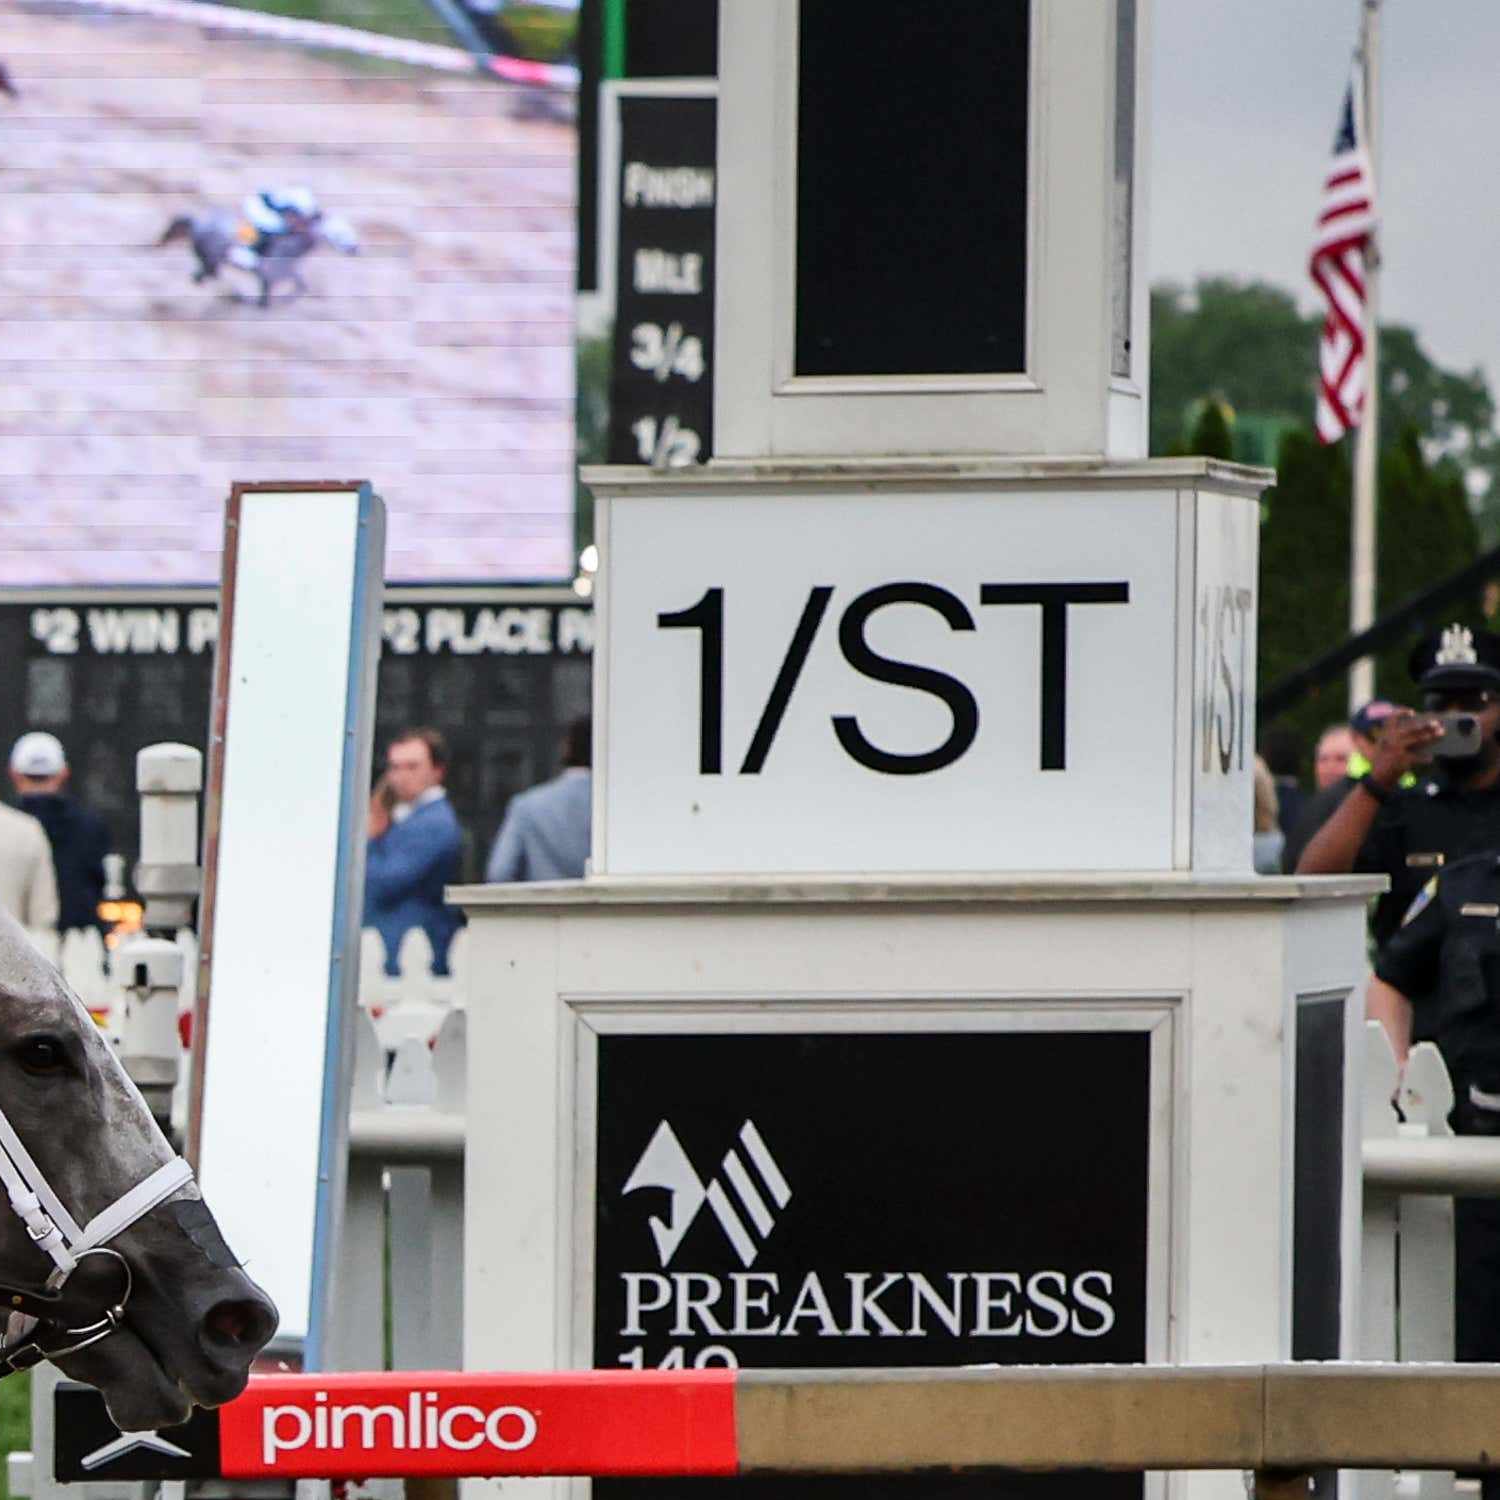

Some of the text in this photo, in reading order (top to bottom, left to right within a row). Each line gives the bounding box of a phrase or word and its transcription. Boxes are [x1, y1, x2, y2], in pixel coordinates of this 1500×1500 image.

[629, 321, 704, 383] 3/4
[631, 415, 701, 468] 1/2
[86, 607, 181, 654] WIN
[425, 607, 553, 655] PLACE
[657, 581, 1130, 776] 1/ST
[1201, 586, 1252, 774] 1/ST
[618, 1270, 1117, 1338] PREAKNESS
[262, 1391, 538, 1465] pimlico
